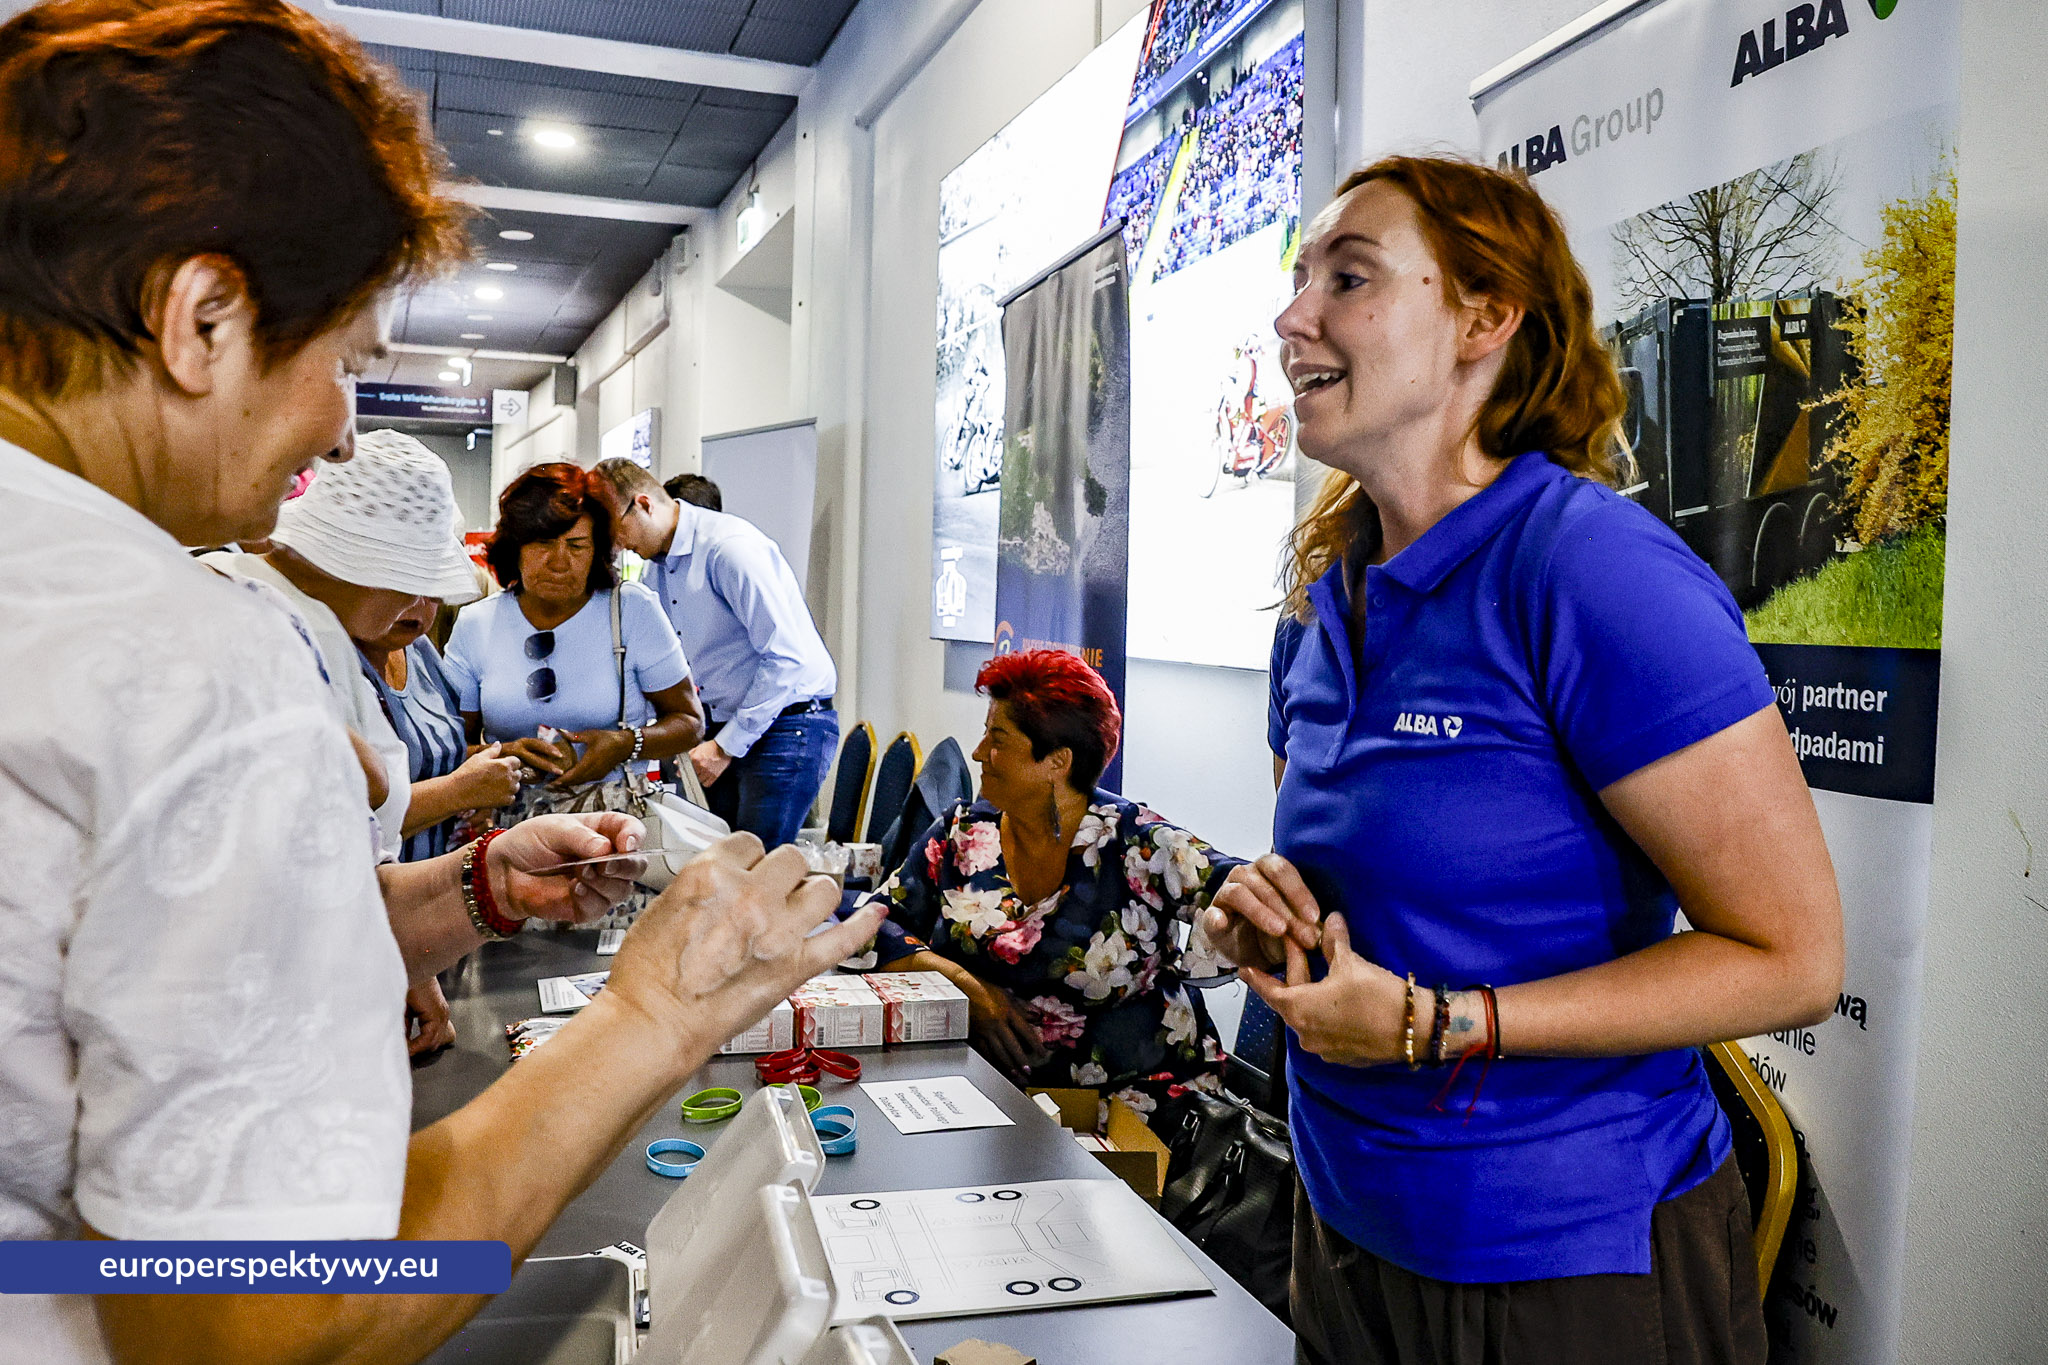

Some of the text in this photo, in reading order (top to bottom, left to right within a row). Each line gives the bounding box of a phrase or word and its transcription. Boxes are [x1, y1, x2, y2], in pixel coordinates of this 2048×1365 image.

[1730, 0, 1849, 88] ALBA
[1497, 87, 1664, 176] ALBA Group
[1769, 677, 1888, 715] wój partner
[1393, 712, 1439, 737] ALBA
[1789, 726, 1885, 765] dpadami
